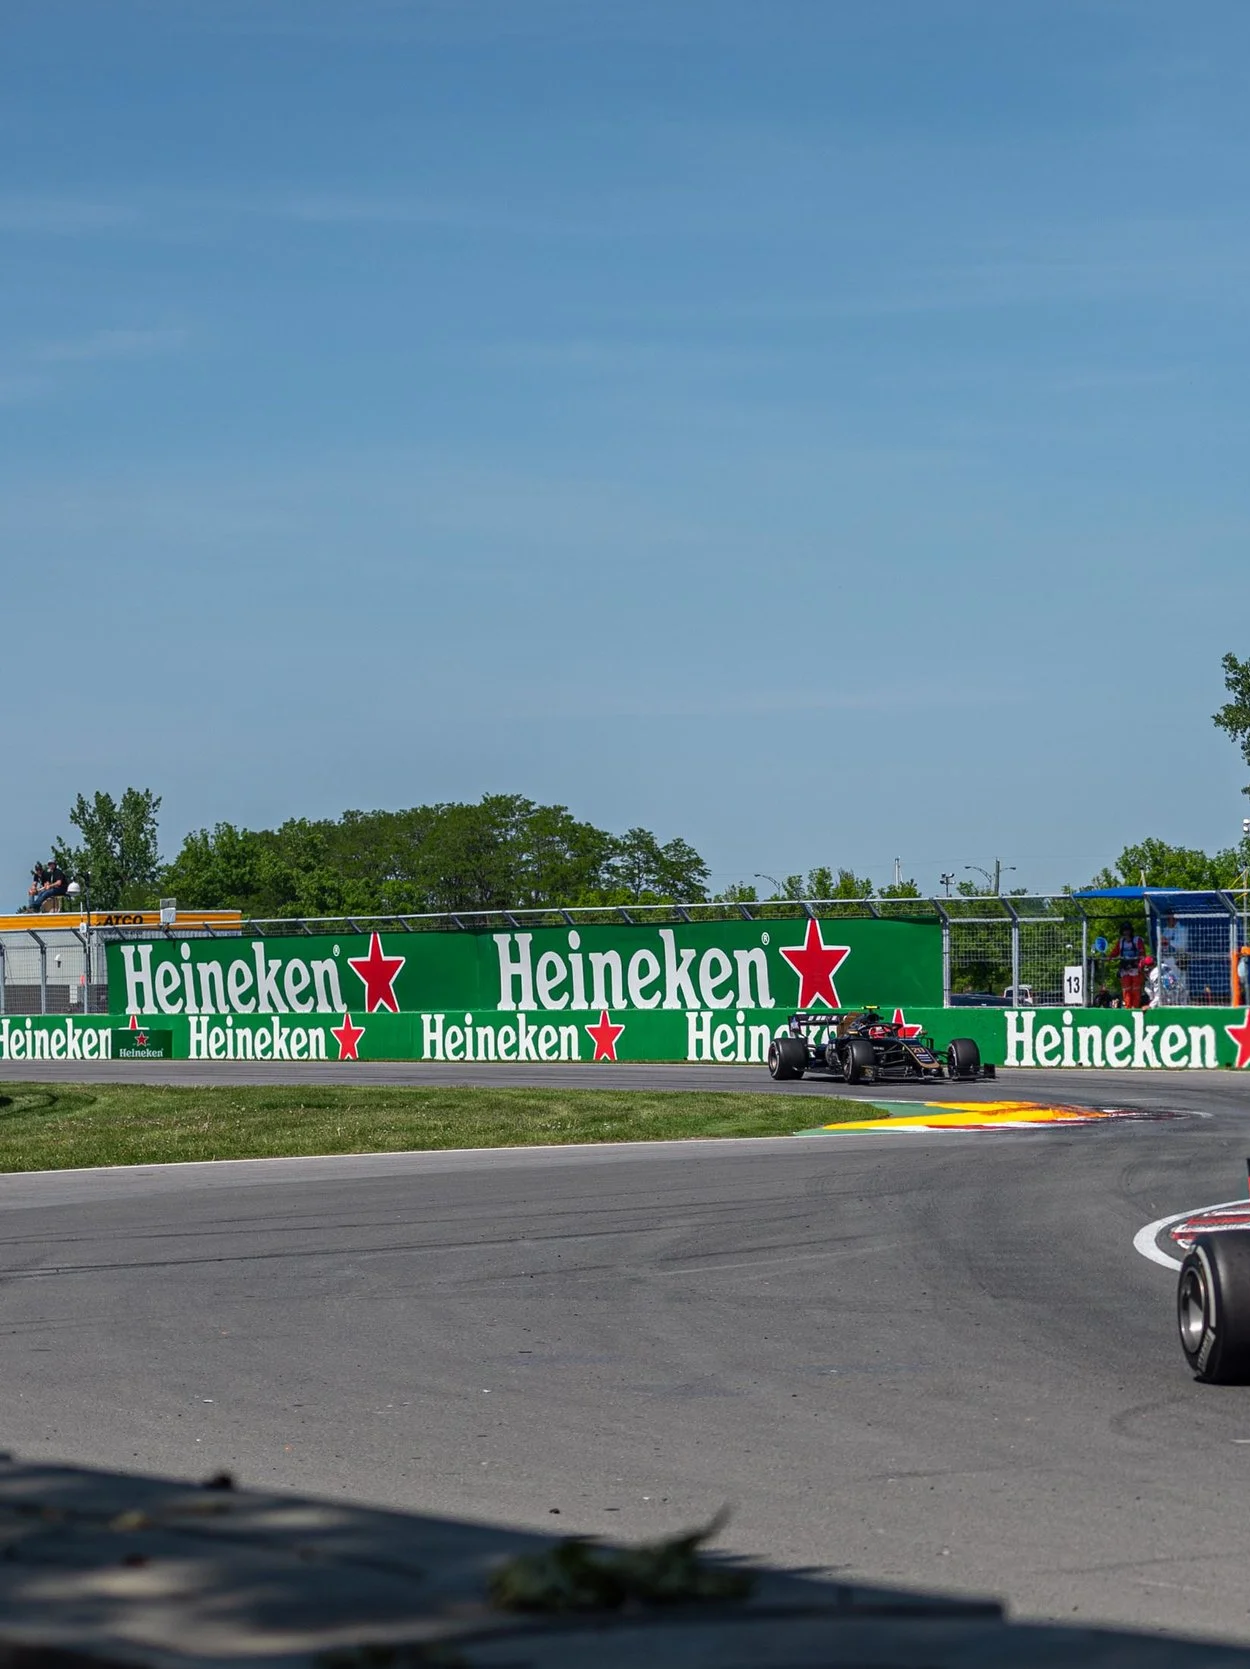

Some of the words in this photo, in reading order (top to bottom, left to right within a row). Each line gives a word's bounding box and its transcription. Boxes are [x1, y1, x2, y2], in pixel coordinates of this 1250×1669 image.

[104, 915, 143, 926] ATCO
[1067, 976, 1080, 994] 13
[188, 1015, 328, 1061] Heineken
[421, 1012, 582, 1061] Heineken
[1004, 1010, 1219, 1068] Heineken
[119, 1048, 164, 1058] Heineken
